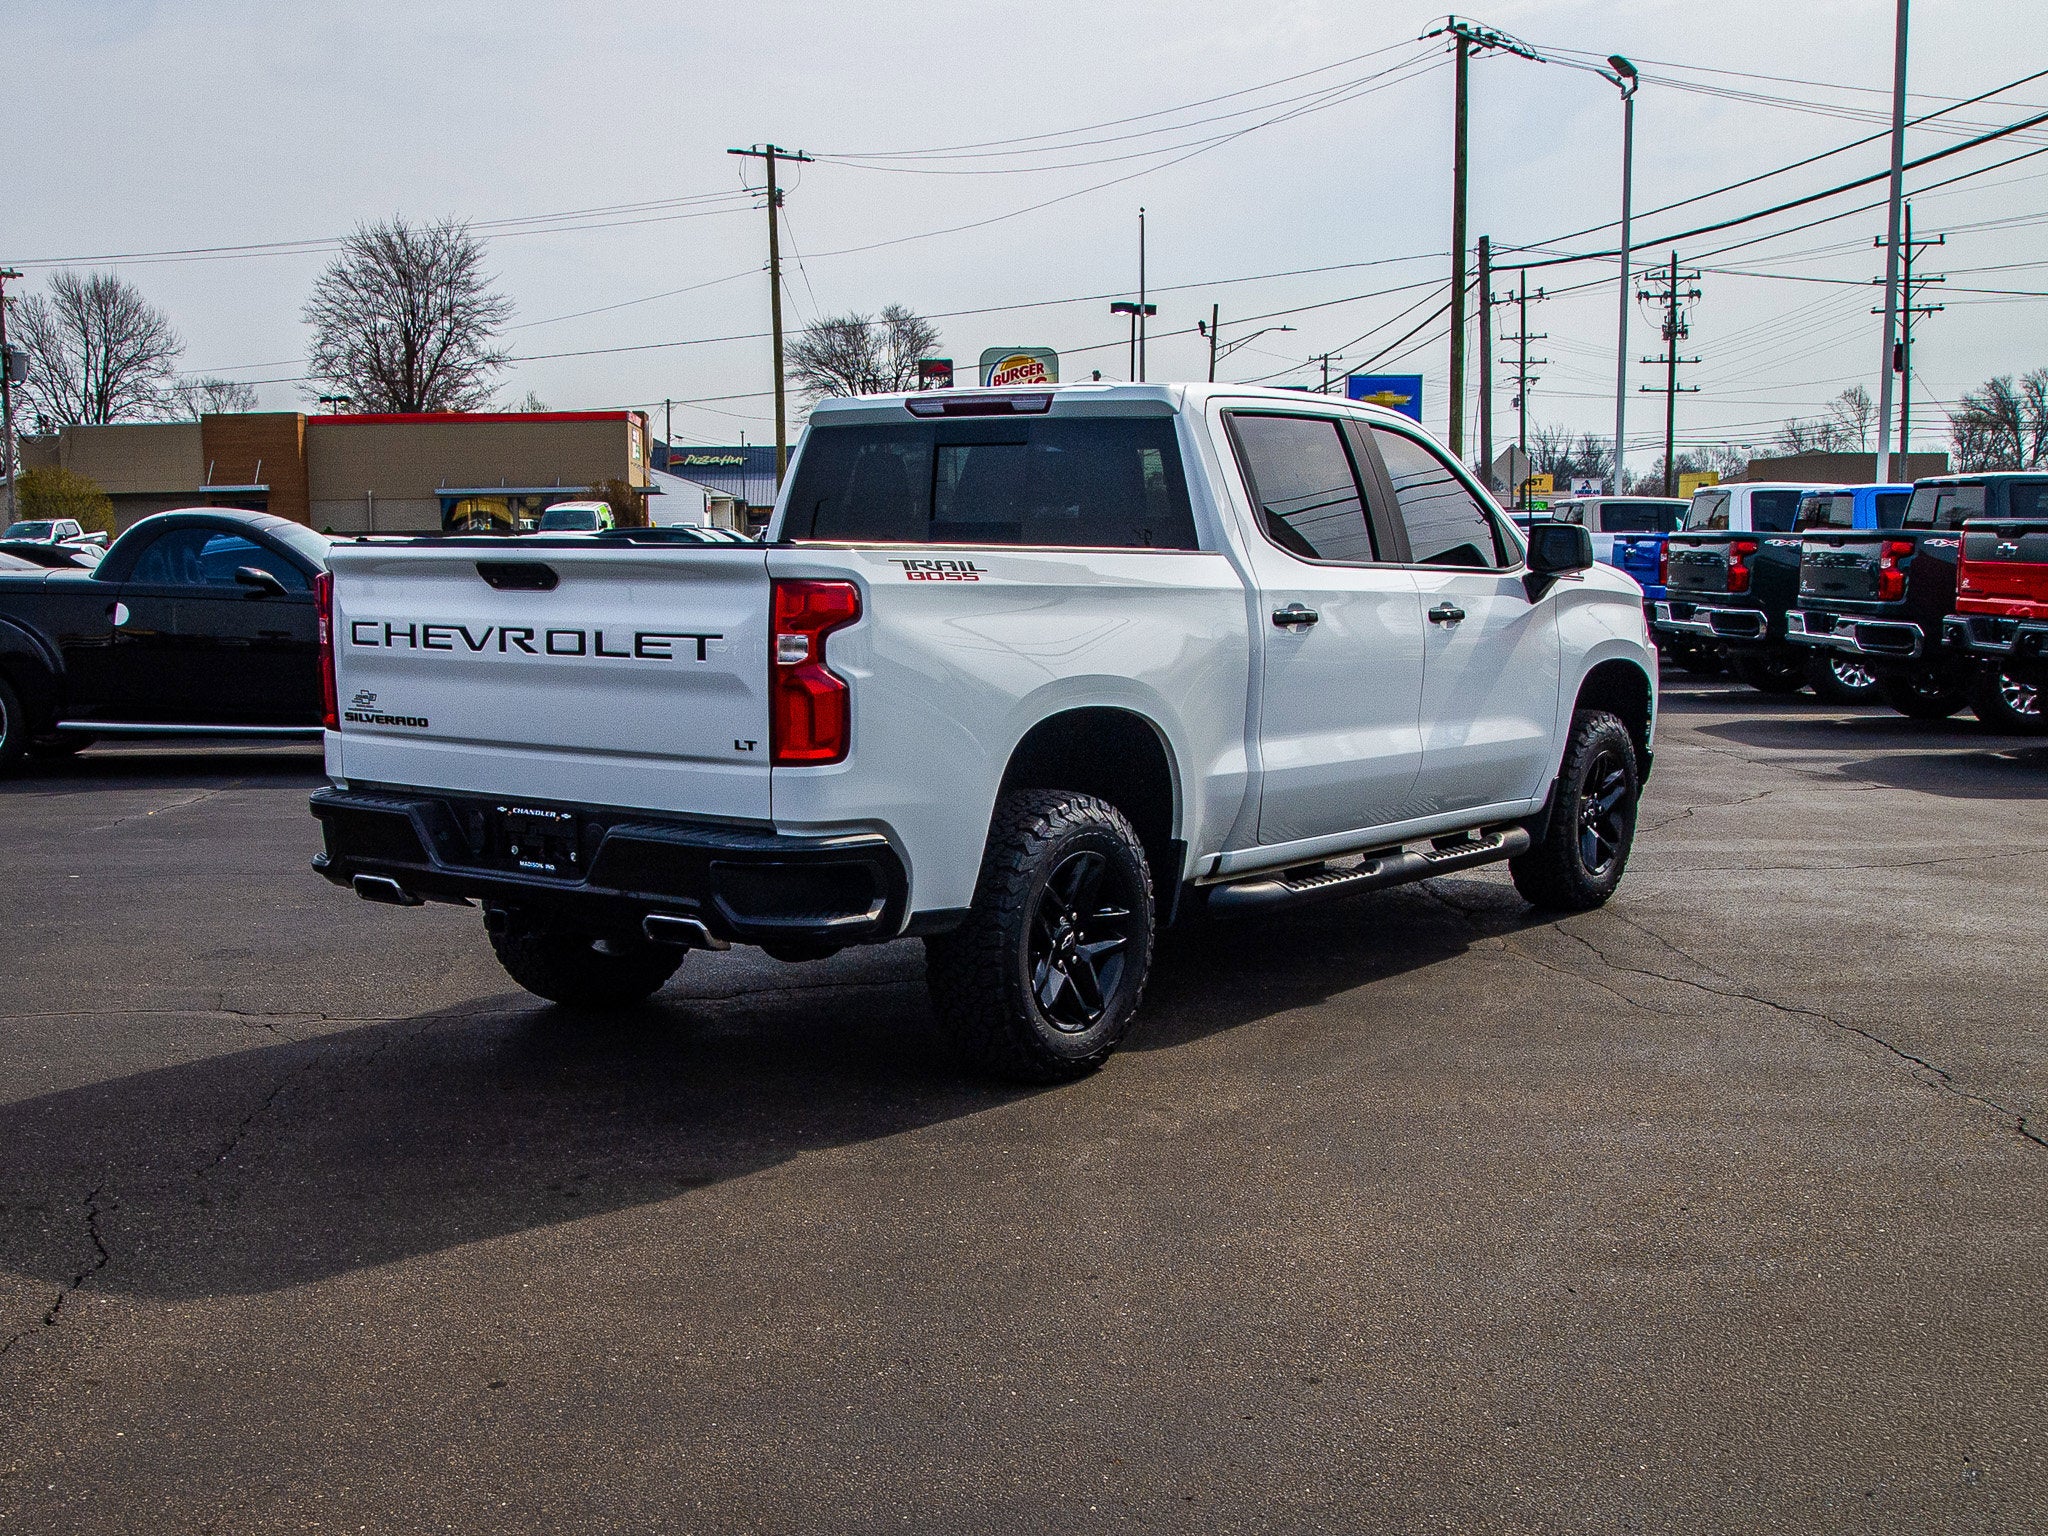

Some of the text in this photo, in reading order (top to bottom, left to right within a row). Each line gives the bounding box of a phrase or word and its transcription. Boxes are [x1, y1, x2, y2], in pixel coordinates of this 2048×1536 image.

[993, 363, 1045, 386] BURGER
[1923, 538, 1960, 548] 4X
[888, 559, 988, 573] TRAIL
[905, 571, 980, 581] BOSS
[351, 621, 724, 661] CHEVROLET
[344, 712, 429, 727] SILVERADO
[734, 739, 757, 751] LT
[512, 807, 556, 818] CHANDLER
